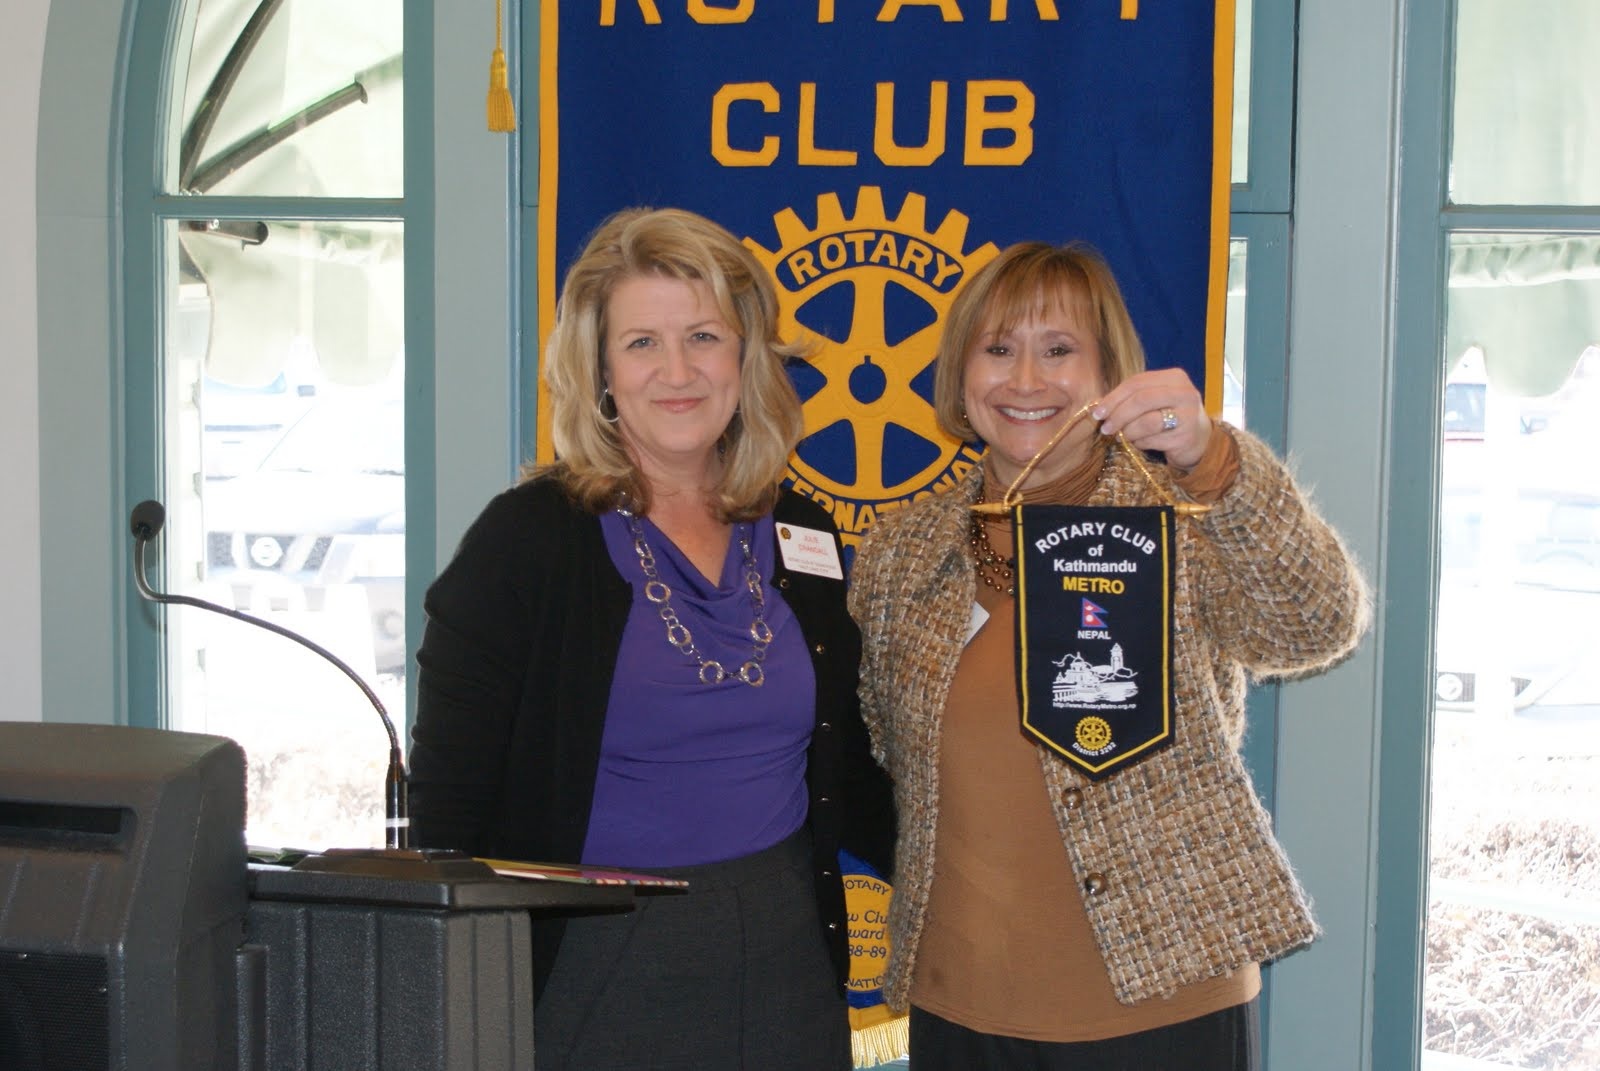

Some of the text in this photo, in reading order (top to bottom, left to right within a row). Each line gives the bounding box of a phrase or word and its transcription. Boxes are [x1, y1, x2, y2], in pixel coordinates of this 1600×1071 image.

[711, 80, 1035, 167] CLUB
[787, 231, 961, 288] ROTARY
[1034, 522, 1157, 556] ROTARY CLUB
[1088, 544, 1104, 558] of
[1053, 559, 1137, 573] Kathmandu
[1063, 576, 1125, 595] METRO
[1077, 629, 1111, 641] NEPAL
[1072, 742, 1099, 757] District
[843, 879, 890, 895] OTARY
[864, 910, 888, 924] Clu
[848, 928, 885, 940] ward
[848, 945, 887, 959] 88-89
